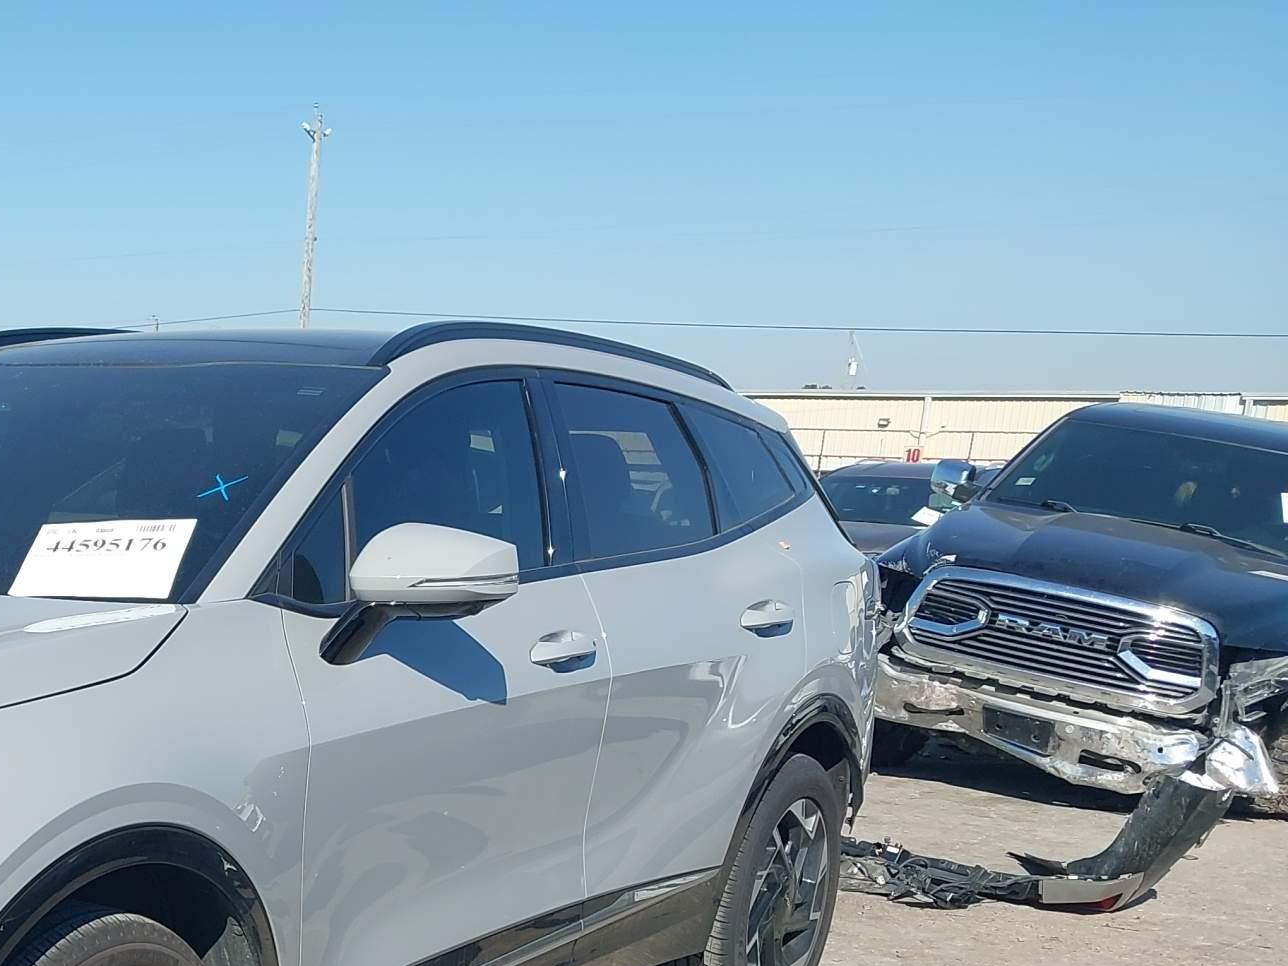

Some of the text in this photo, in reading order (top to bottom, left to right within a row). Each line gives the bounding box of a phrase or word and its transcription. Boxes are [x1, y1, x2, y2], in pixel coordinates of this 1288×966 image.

[905, 448, 921, 463] 10
[46, 537, 168, 553] 44595176
[996, 612, 1109, 649] RAM
